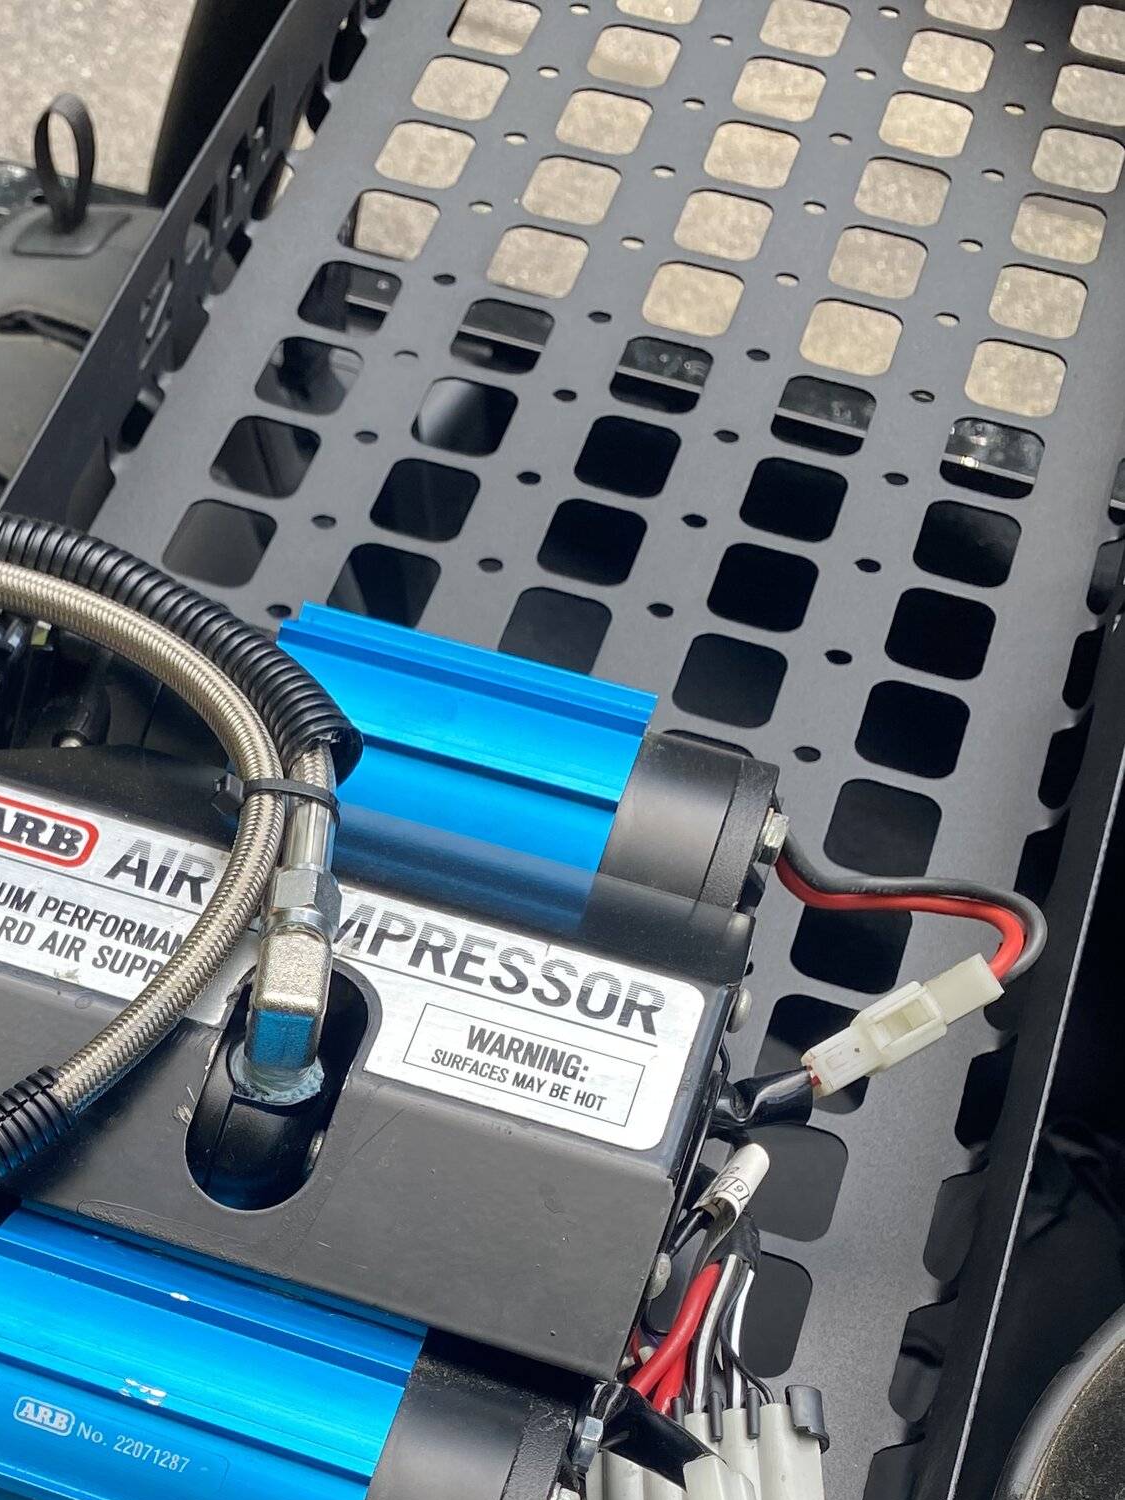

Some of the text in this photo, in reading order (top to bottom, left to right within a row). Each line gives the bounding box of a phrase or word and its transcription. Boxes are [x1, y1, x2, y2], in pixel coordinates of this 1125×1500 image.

[104, 839, 217, 904] AIR
[40, 930, 87, 963] AIR
[91, 945, 166, 983] SUPP
[431, 1048, 608, 1112] SURFACES MAY BE HOT
[466, 1025, 589, 1082] WARNING:
[17, 1401, 192, 1474] ARB No. 22071287
